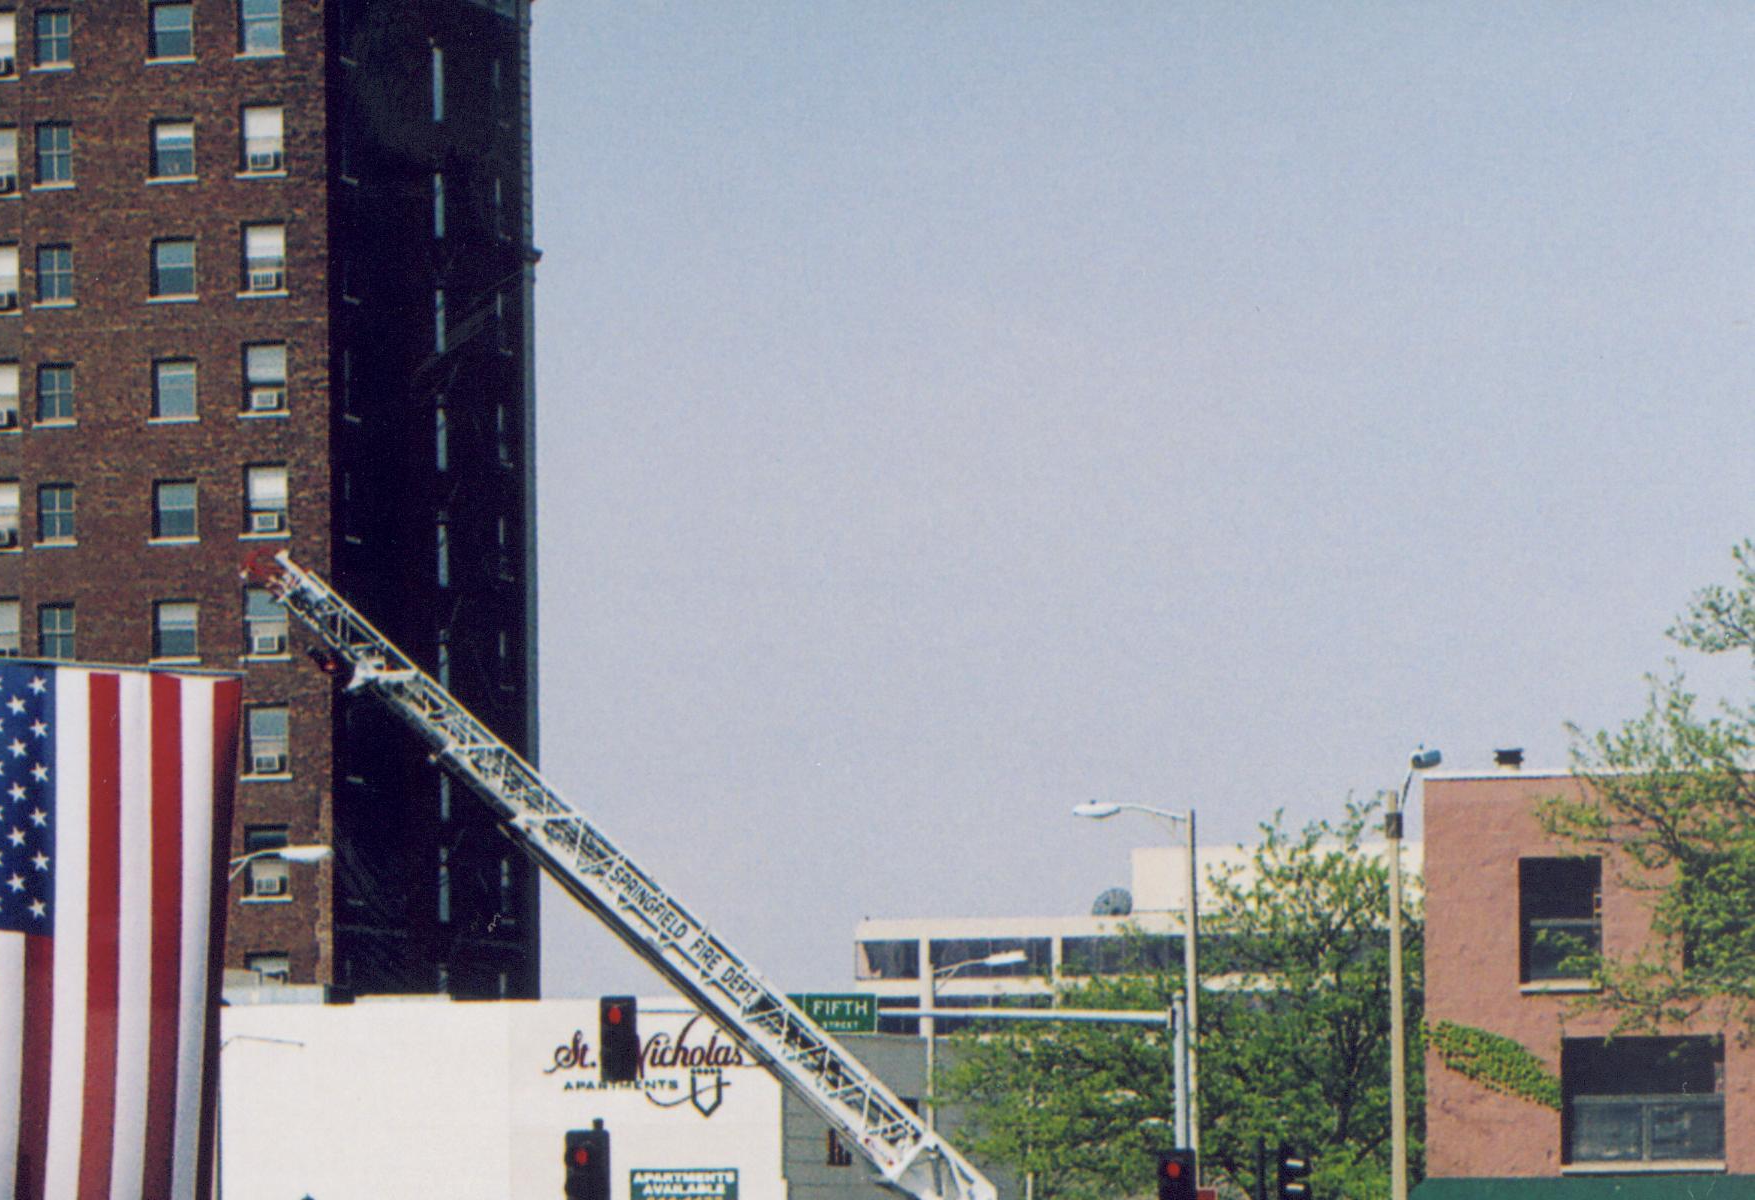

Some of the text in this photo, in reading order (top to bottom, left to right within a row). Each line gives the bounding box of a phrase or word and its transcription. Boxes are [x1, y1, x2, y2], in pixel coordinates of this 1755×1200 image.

[609, 866, 759, 1004] SPRINGFIELD FIRE DEPT.
[813, 1000, 868, 1016] FIFTH
[543, 1029, 596, 1074] St.
[633, 1171, 736, 1184] APARTMENTS
[642, 1184, 726, 1196] AVAILABLE
